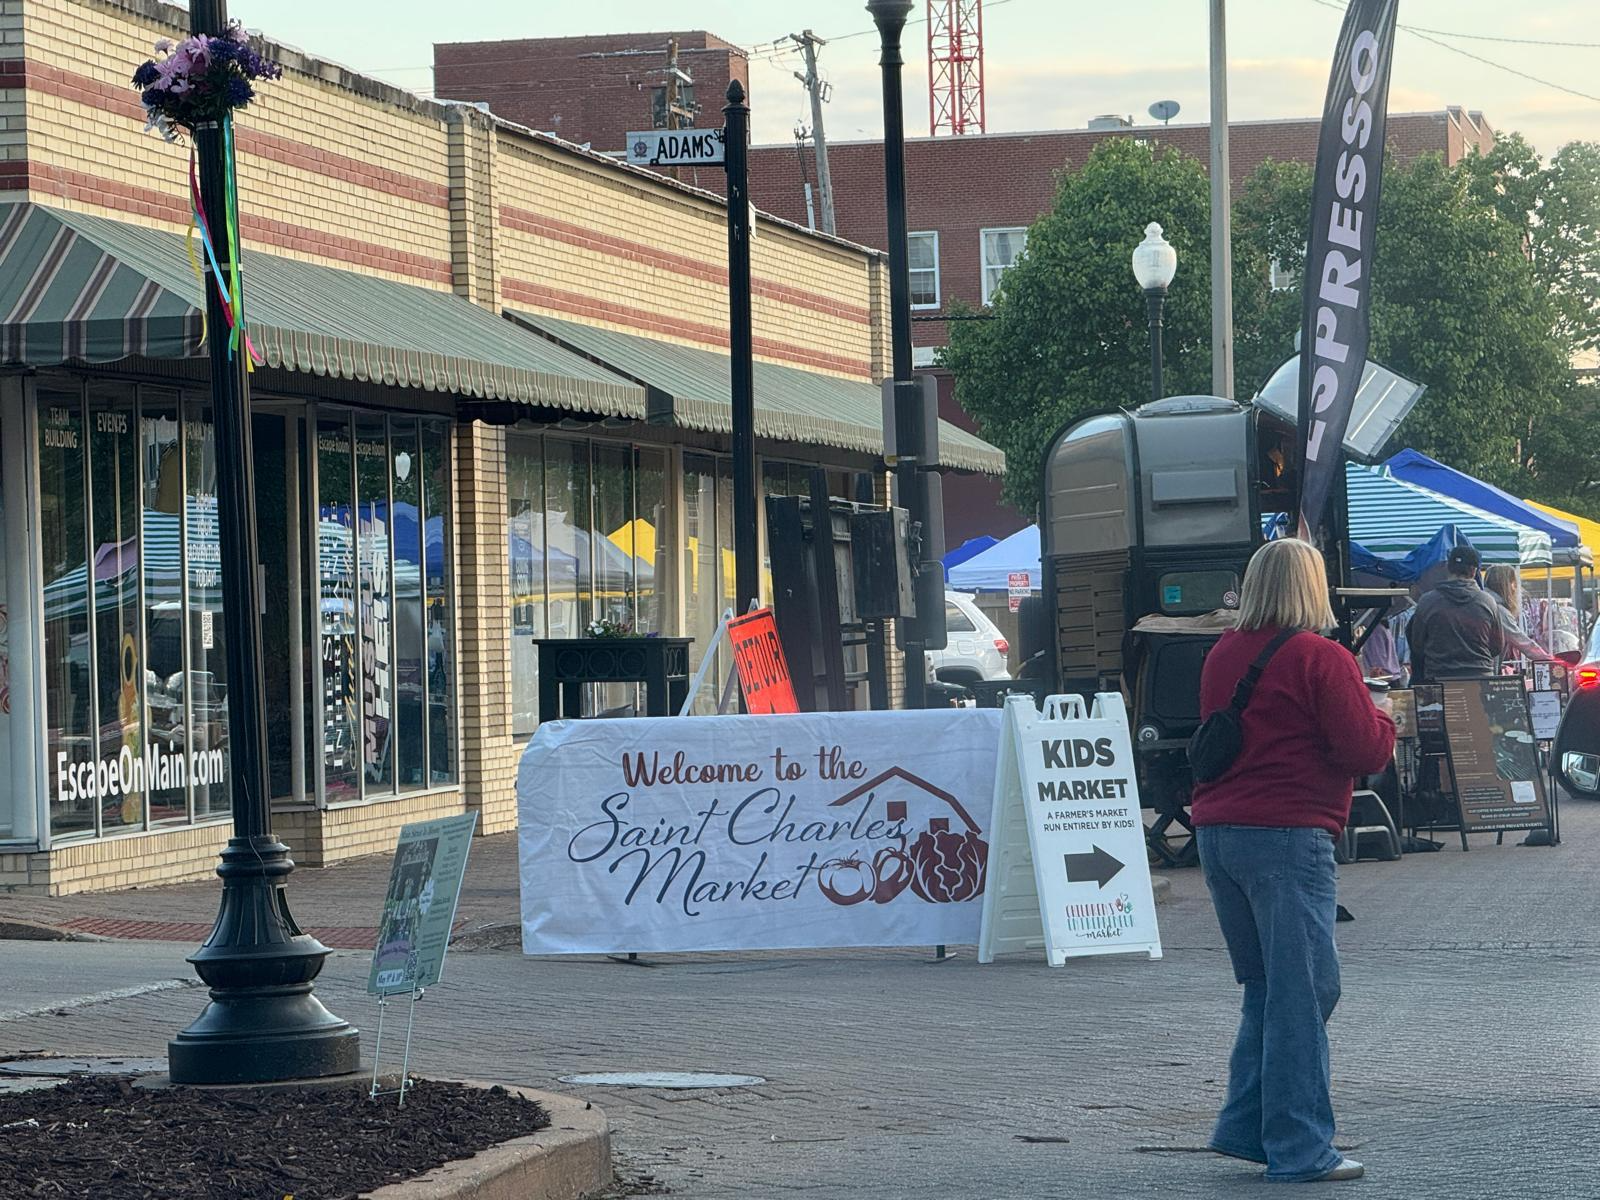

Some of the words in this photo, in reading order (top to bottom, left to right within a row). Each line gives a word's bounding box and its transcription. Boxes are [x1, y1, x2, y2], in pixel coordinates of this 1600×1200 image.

[658, 134, 714, 159] ADAMS
[50, 407, 70, 426] TEAM
[97, 412, 127, 433] EVENTS
[45, 429, 77, 448] BUILDING
[318, 435, 335, 455] Escape
[196, 569, 217, 587] TODAY!
[371, 501, 390, 720] HEIST
[360, 517, 377, 765] MUSEUM
[735, 631, 787, 694] DETOUR
[323, 676, 334, 766] THE
[622, 750, 763, 787] Welcome
[770, 747, 806, 780] to
[814, 745, 868, 780] the
[1041, 738, 1115, 769] KIDS
[57, 741, 223, 801] EscapeOnMain.com
[1037, 779, 1128, 801] MARKET
[568, 792, 729, 862] Saint
[727, 787, 913, 846] Charles
[1043, 823, 1061, 832] RUN
[1063, 821, 1099, 831] ENTIRELY
[1102, 821, 1112, 829] BY
[1114, 820, 1135, 828] KIDS!
[1047, 811, 1054, 820] A
[1055, 810, 1094, 819] FARMER'S
[1096, 808, 1128, 818] MARKET
[609, 847, 828, 917] Market
[1075, 924, 1123, 939] market
